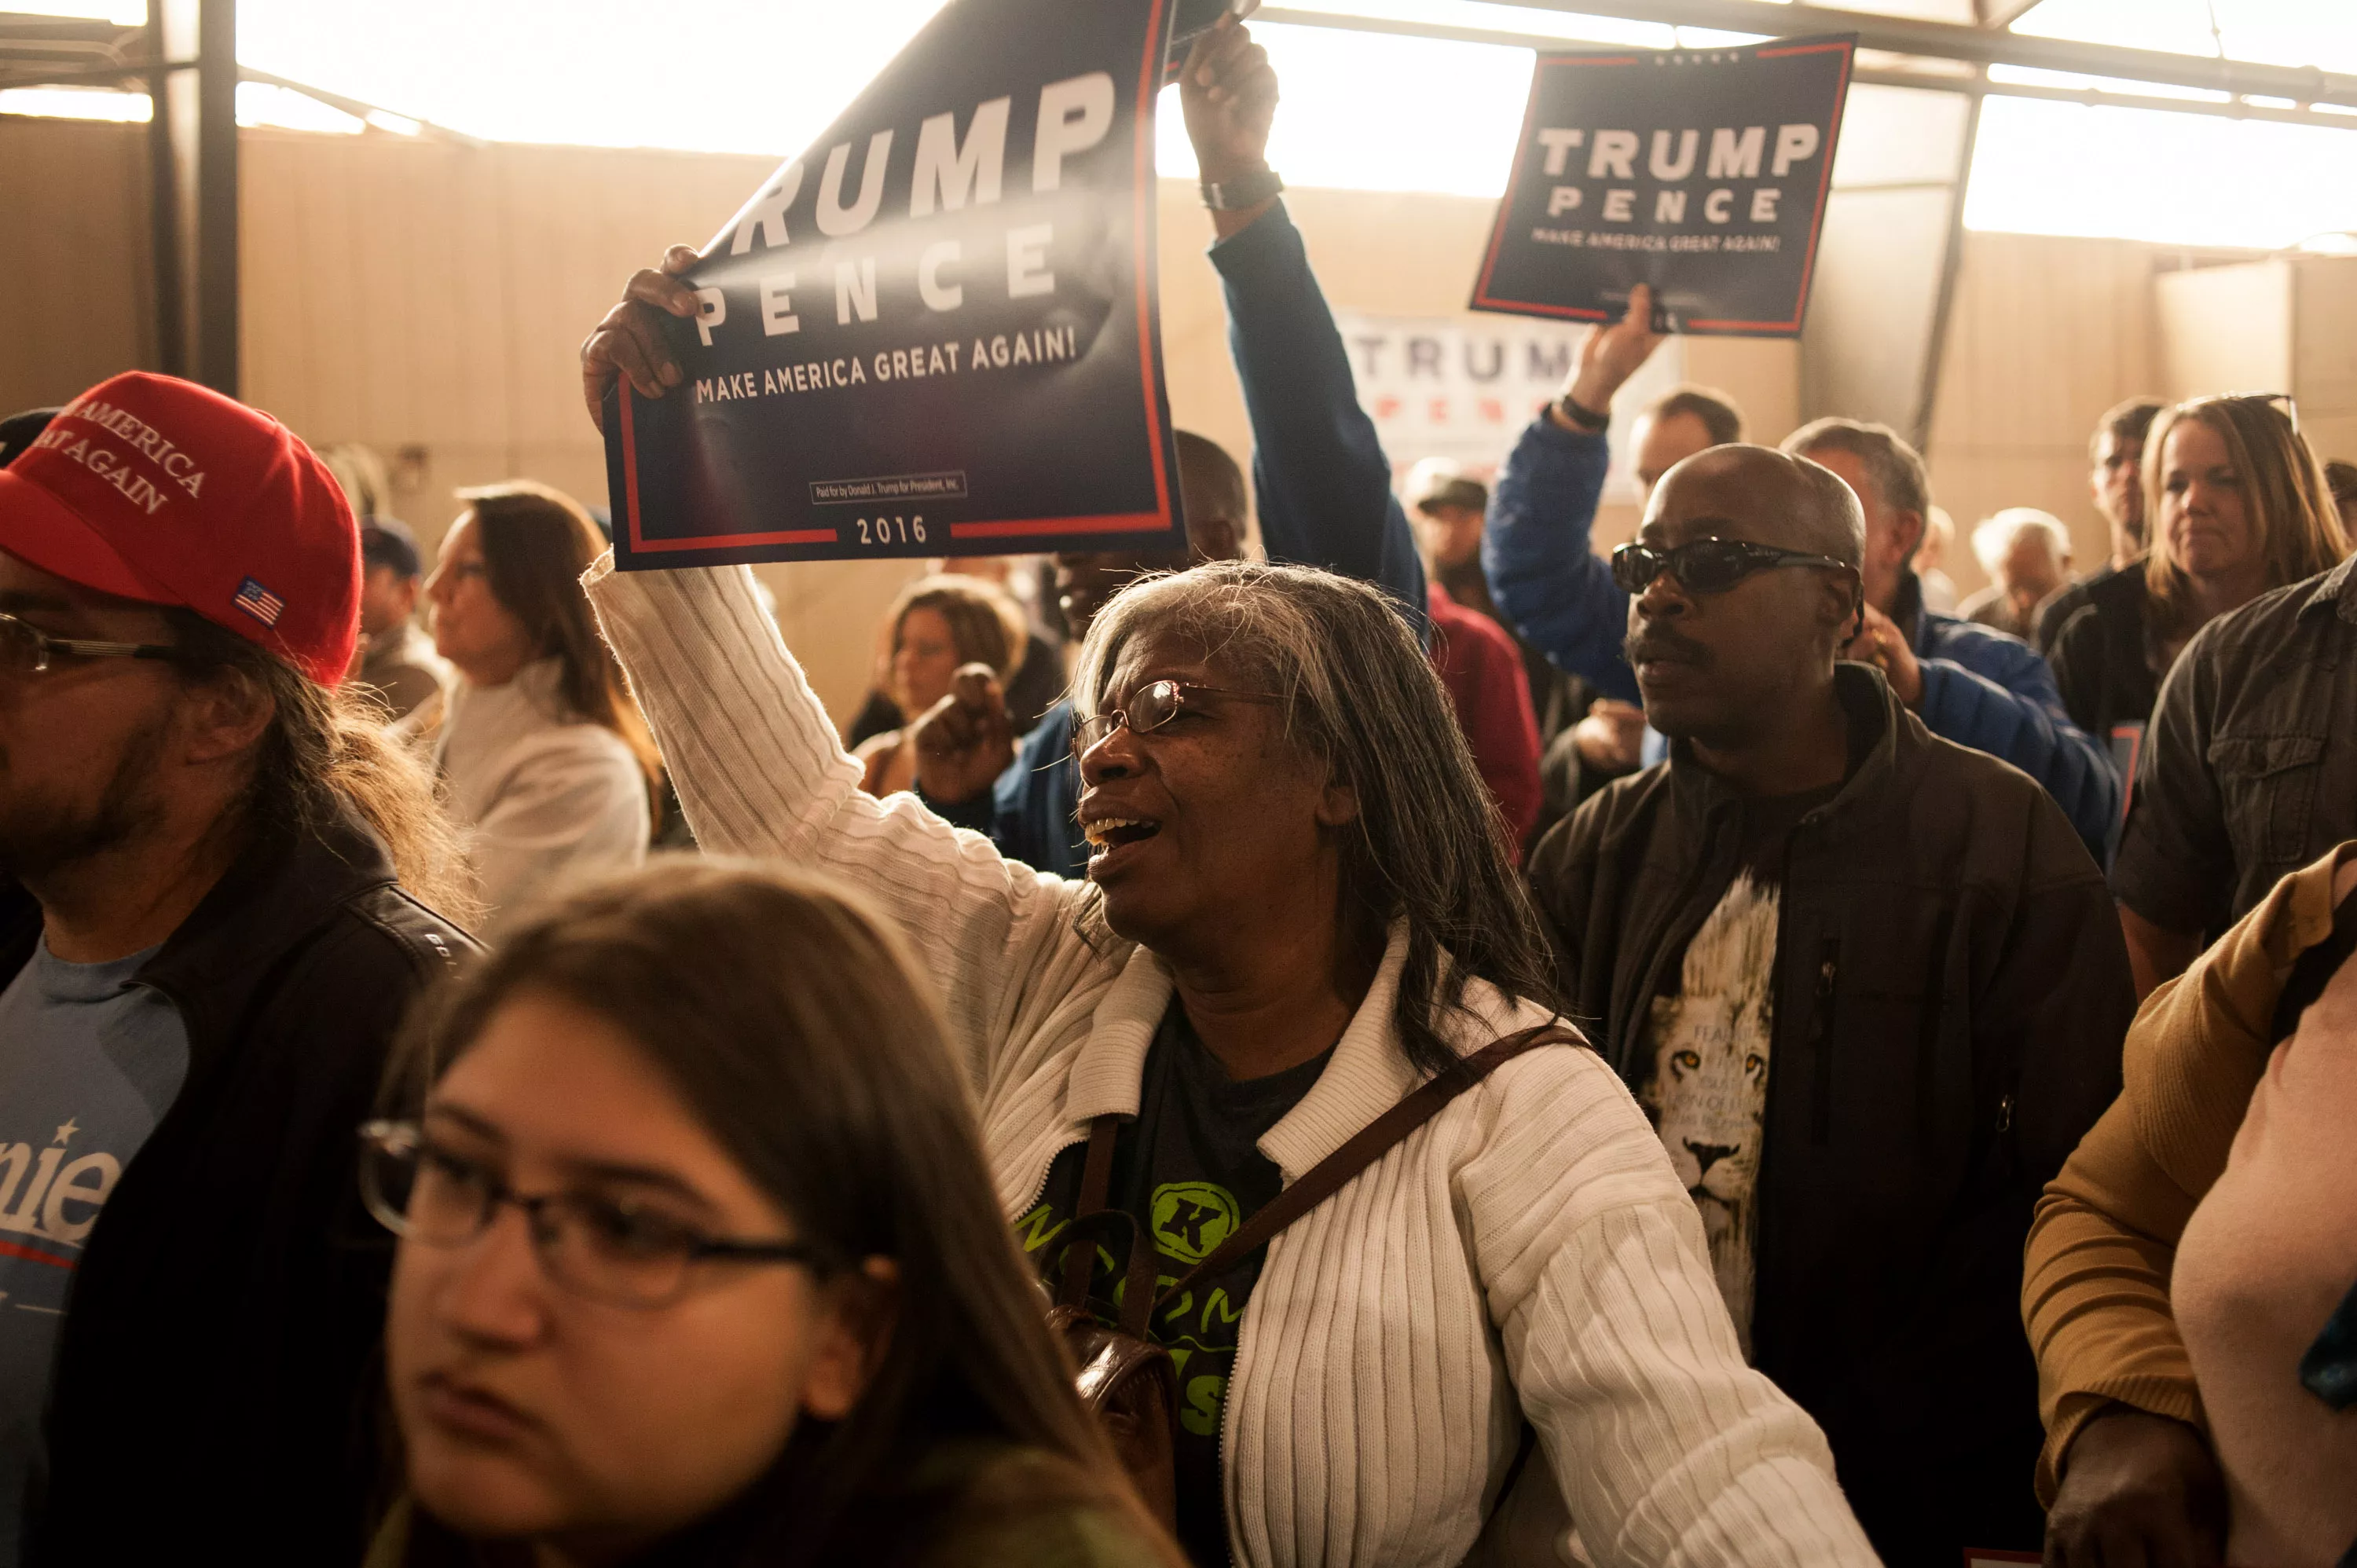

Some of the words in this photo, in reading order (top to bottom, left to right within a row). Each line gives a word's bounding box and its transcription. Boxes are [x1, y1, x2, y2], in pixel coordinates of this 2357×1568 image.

[730, 71, 1115, 255] RUMP
[1538, 123, 1820, 181] TRUMP
[1546, 185, 1782, 223] PENCE
[1586, 233, 1668, 252] AMERICA
[1669, 235, 1721, 252] GREAT
[694, 223, 1055, 346] PENCE
[696, 371, 758, 403] MAKE
[764, 357, 867, 395] AMERICA
[874, 343, 960, 382] GREAT
[972, 325, 1076, 370] AGAIN!
[1354, 335, 1571, 383] TRUM
[62, 438, 168, 515] AGAIN
[73, 400, 205, 499] AMERICA
[816, 485, 830, 497] Paid
[830, 485, 838, 496] for
[838, 483, 848, 499] by
[848, 482, 871, 496] Donald
[877, 481, 899, 496] Trump
[899, 479, 909, 493] for
[856, 515, 927, 544] 2016
[1159, 1197, 1223, 1253] K
